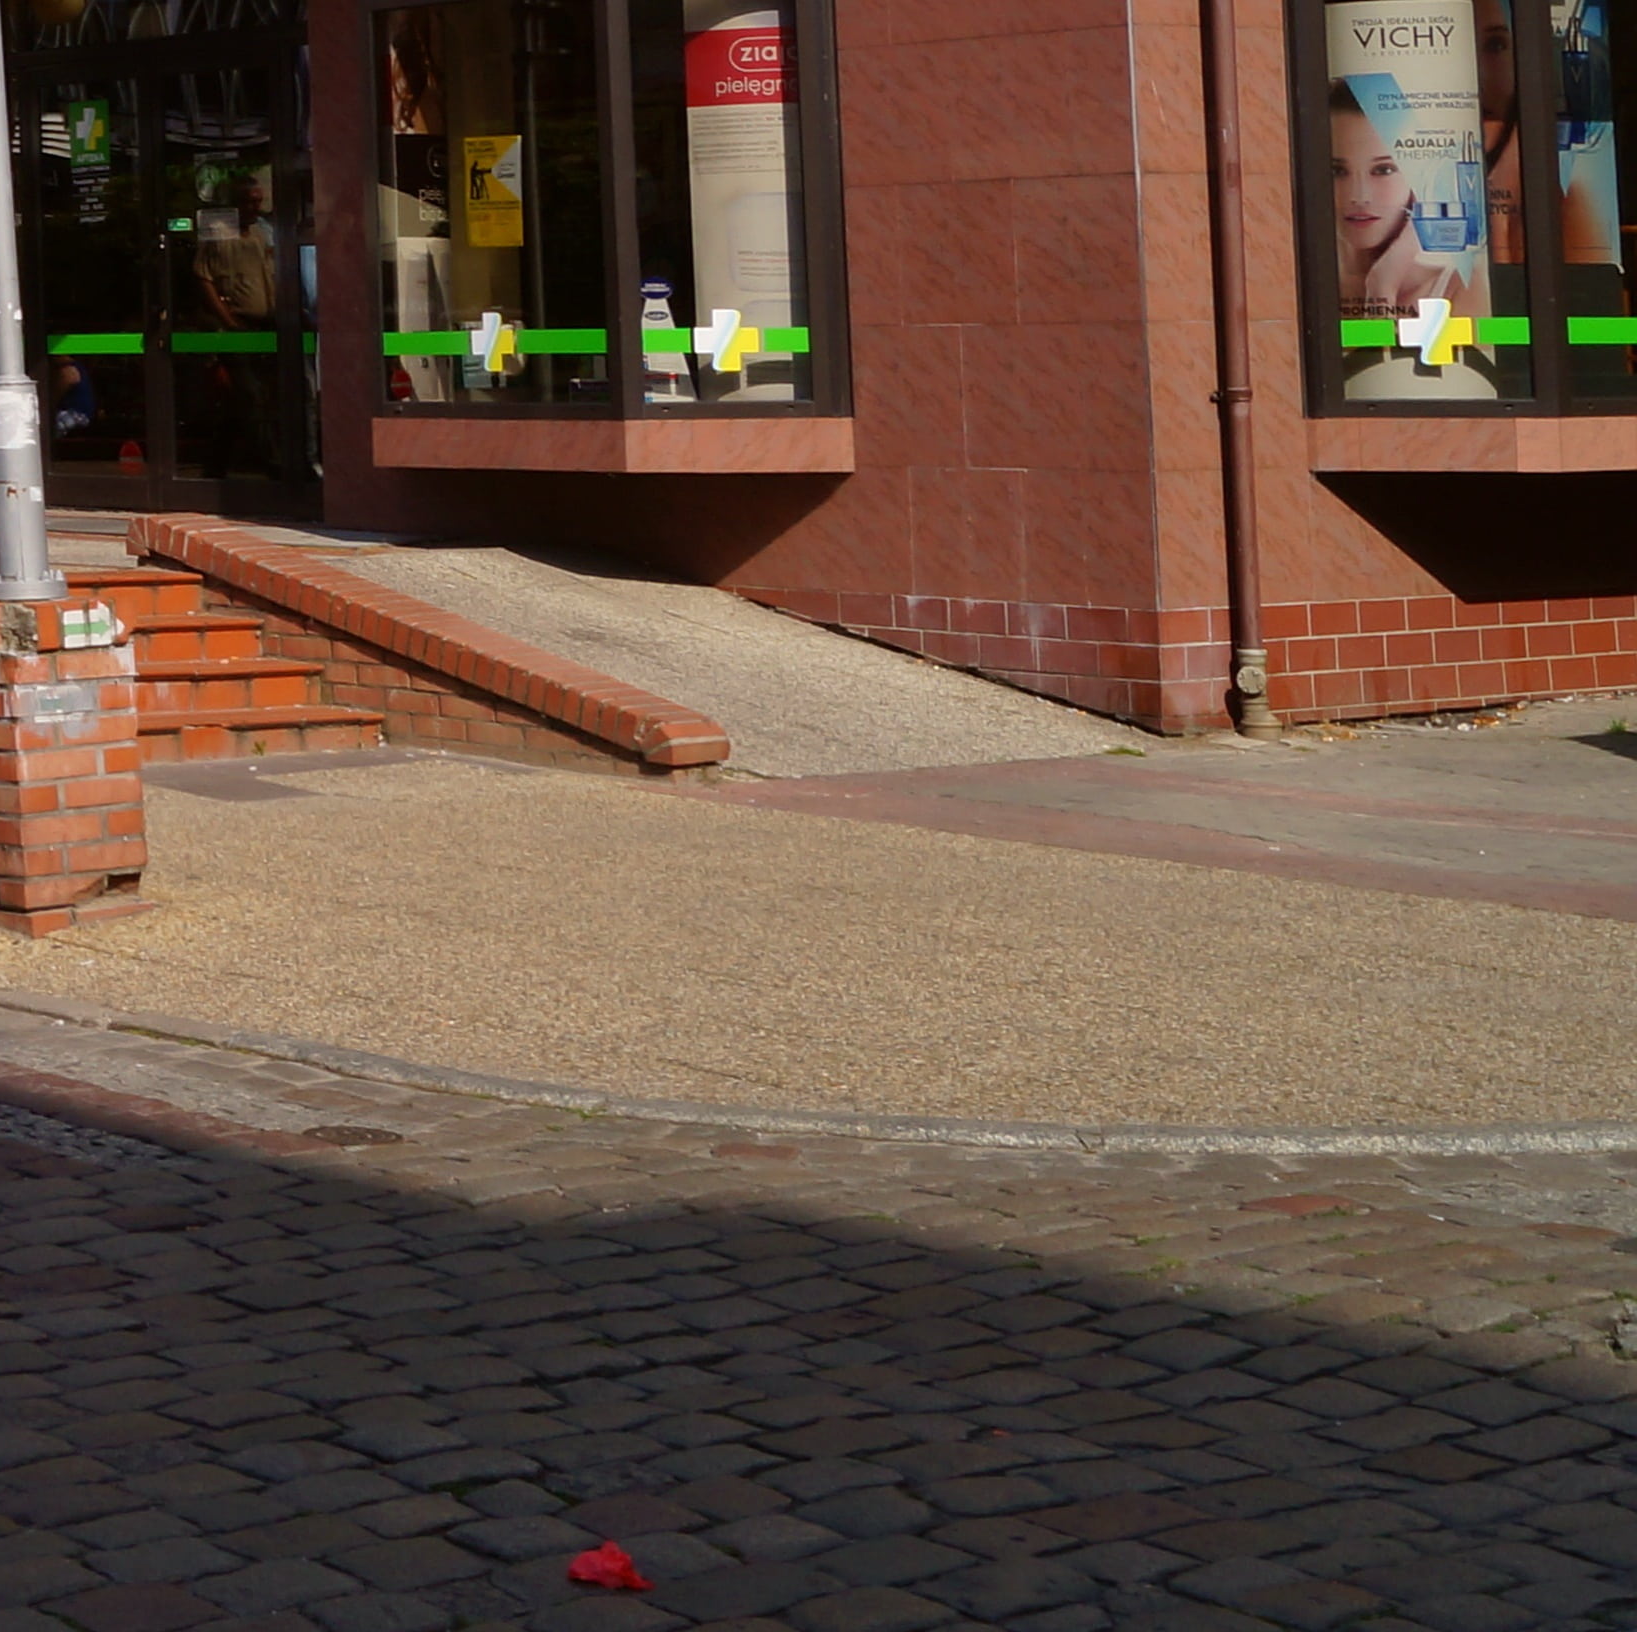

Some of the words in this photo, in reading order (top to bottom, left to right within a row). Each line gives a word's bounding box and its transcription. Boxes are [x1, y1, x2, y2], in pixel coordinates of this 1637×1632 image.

[1353, 25, 1455, 49] VICHY
[1394, 138, 1456, 148] AQUALIA
[1396, 149, 1459, 160] THERMAL
